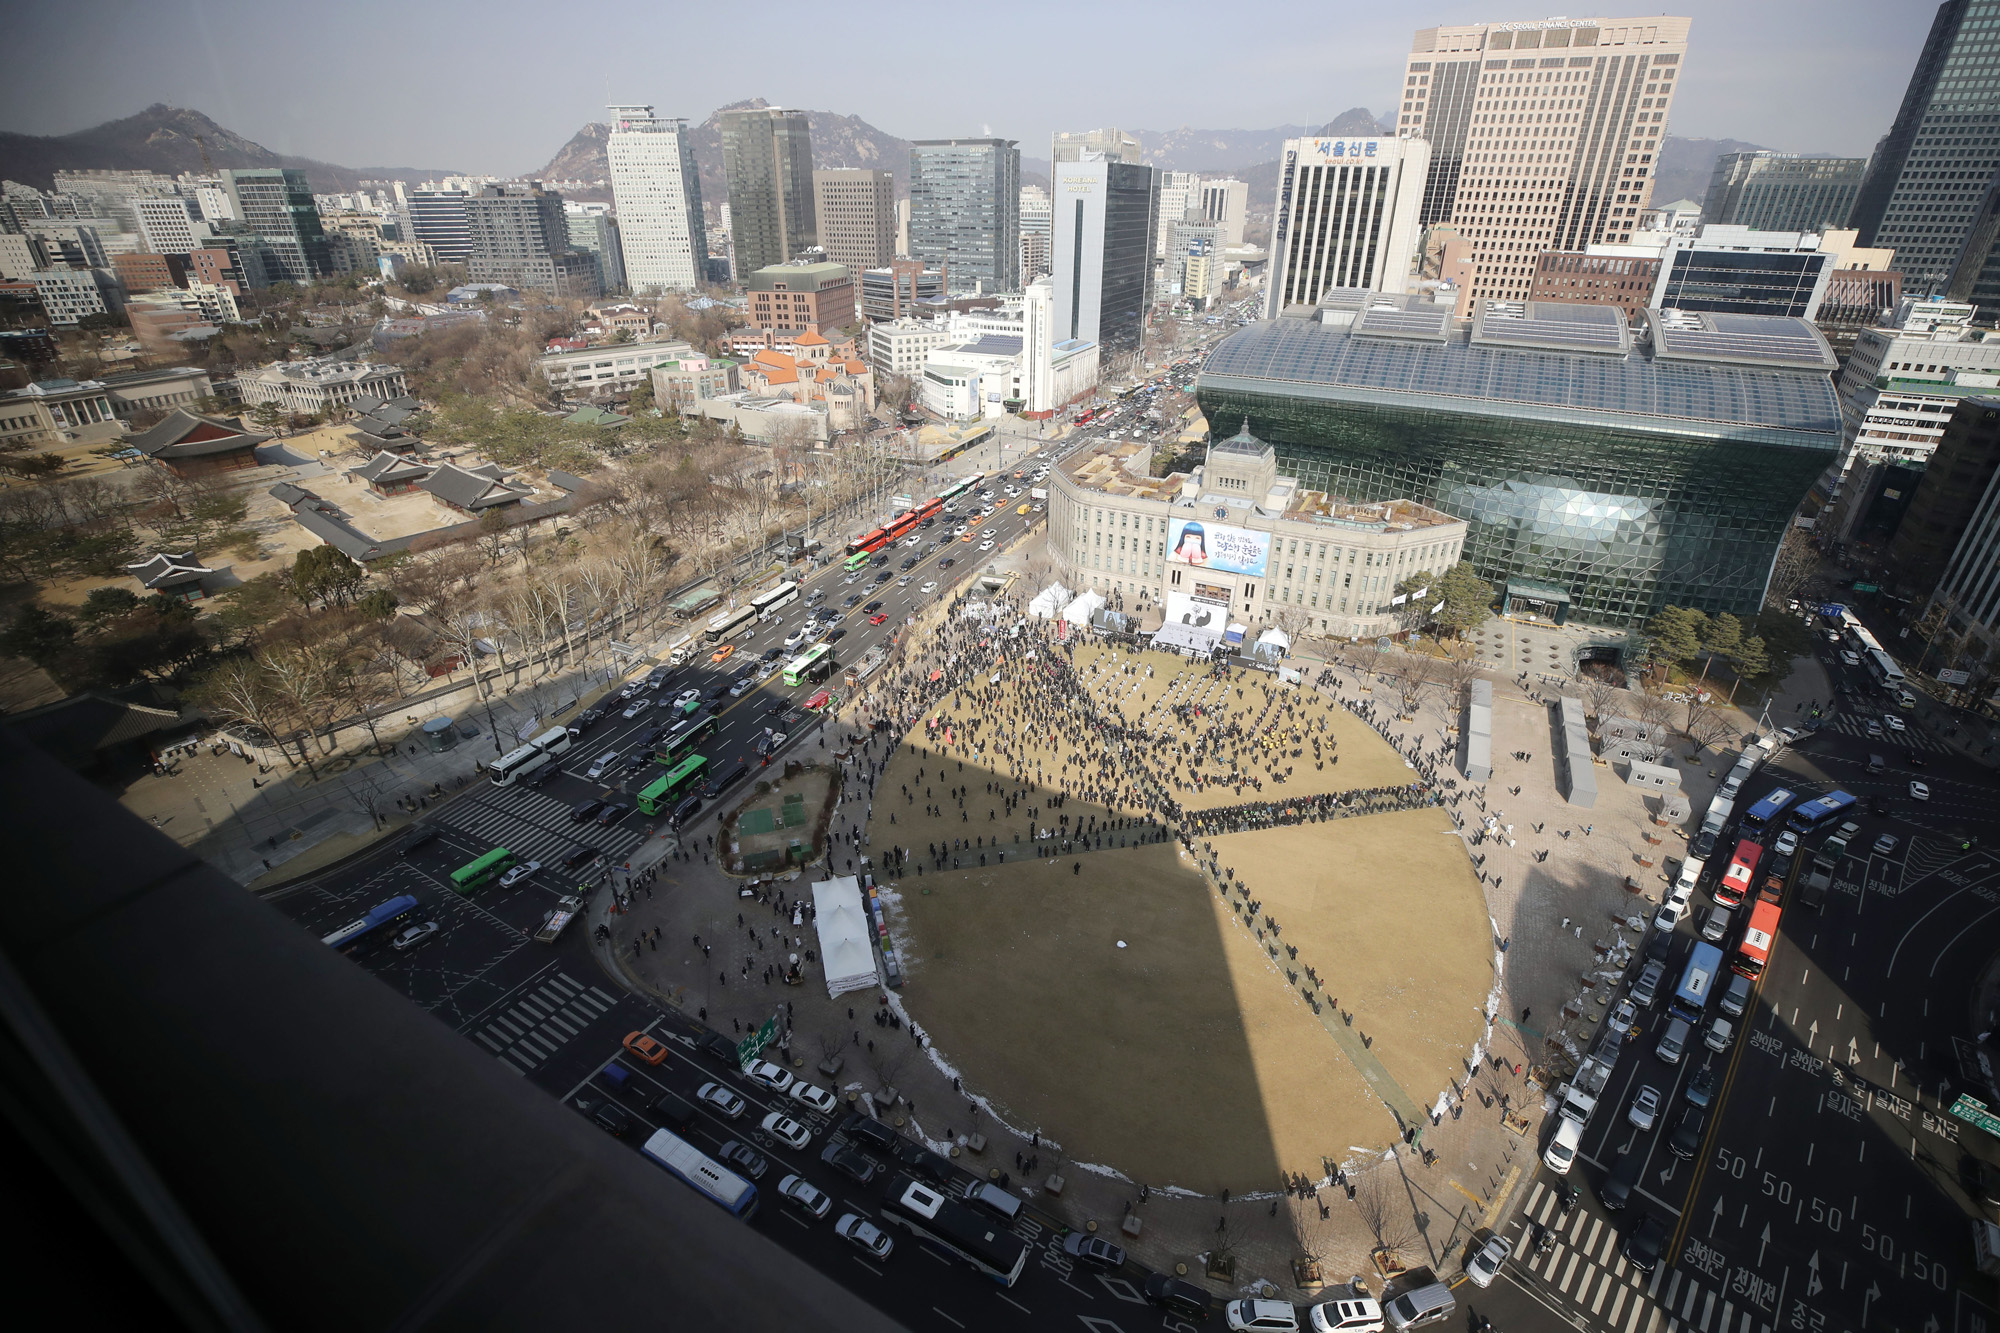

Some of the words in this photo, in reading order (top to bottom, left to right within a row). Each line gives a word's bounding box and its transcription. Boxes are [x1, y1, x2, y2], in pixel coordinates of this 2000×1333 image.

[1538, 21, 1568, 29] FINANCE
[1569, 19, 1597, 28] CENTER
[1317, 140, 1378, 157] 서울신문
[1276, 149, 1297, 242] 한국프레스센터
[1750, 1029, 1783, 1058] 광화문
[1790, 1047, 1824, 1078] 광화문
[1826, 1090, 1864, 1123] 을지로
[1876, 1088, 1912, 1121] 을지로
[1922, 1109, 1959, 1144] 을지로
[1716, 1147, 1746, 1179] 50
[1761, 1171, 1793, 1205] 50
[1810, 1196, 1842, 1232] 50
[1684, 1236, 1726, 1281] 광화문
[1862, 1223, 1894, 1261] 50
[1913, 1250, 1947, 1291] 50
[1732, 1265, 1777, 1313] 청계천
